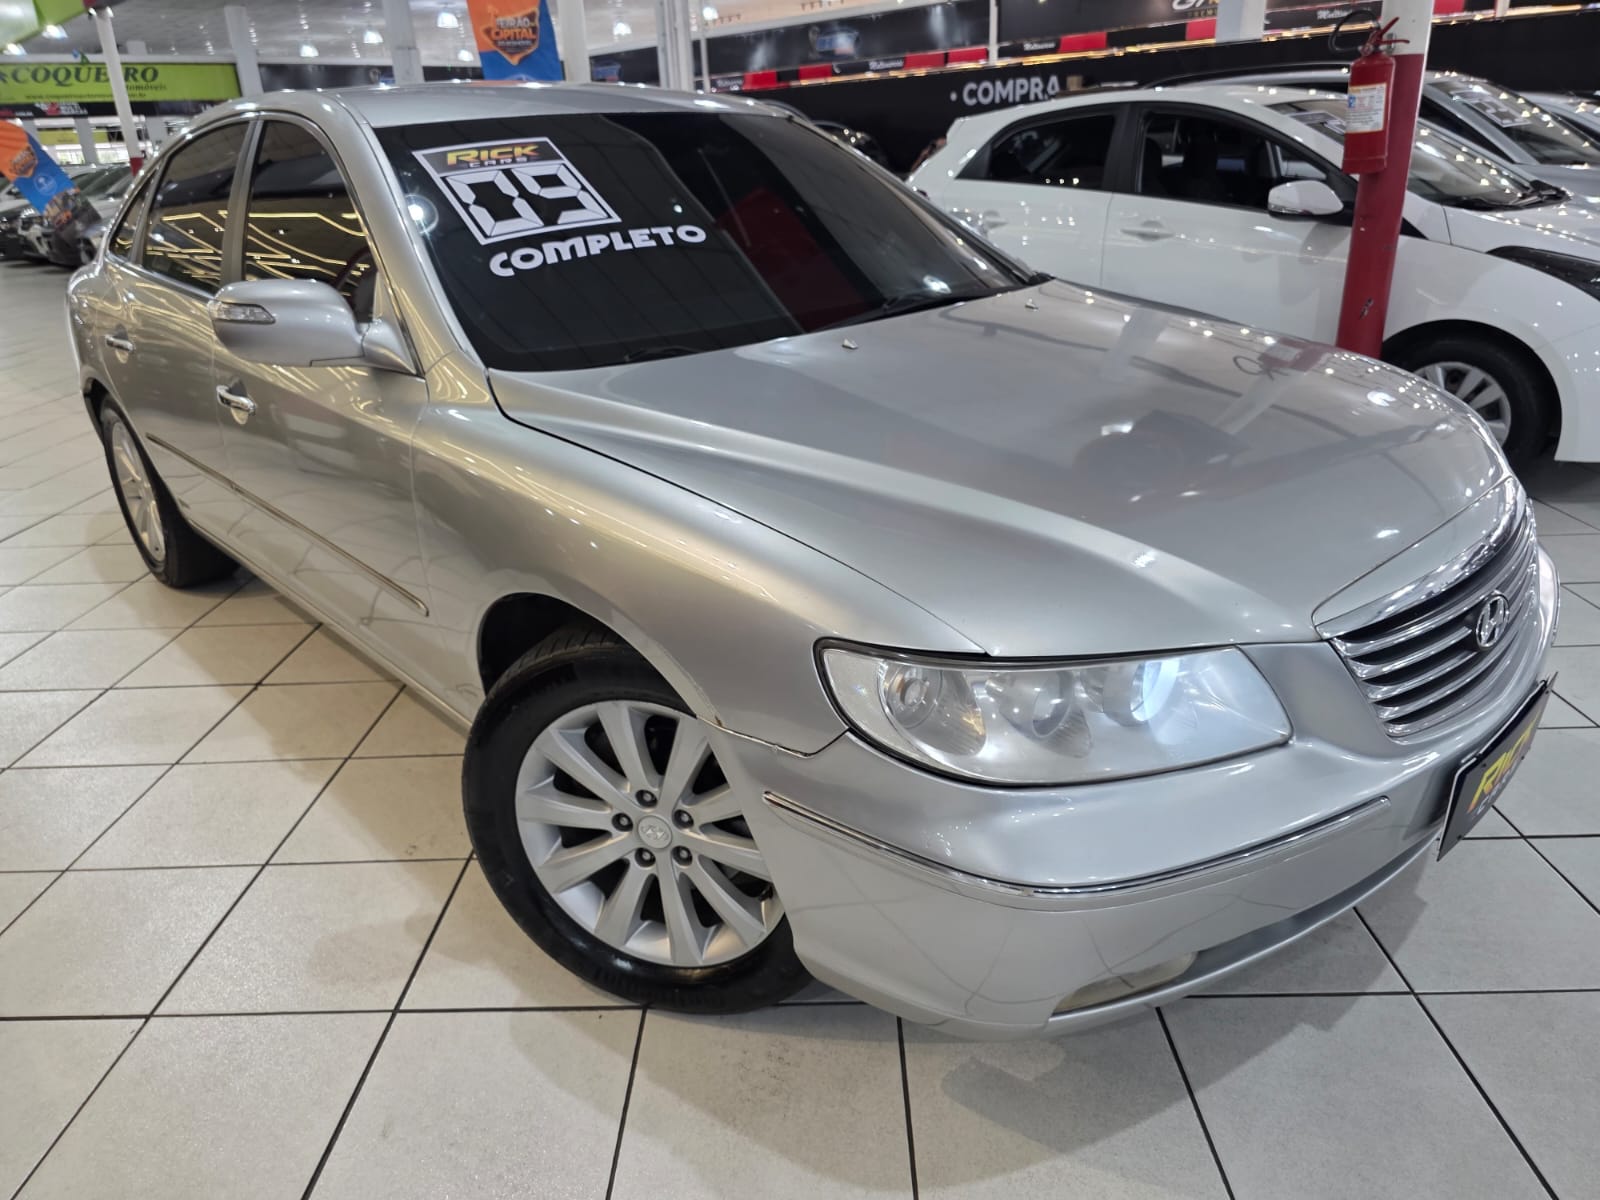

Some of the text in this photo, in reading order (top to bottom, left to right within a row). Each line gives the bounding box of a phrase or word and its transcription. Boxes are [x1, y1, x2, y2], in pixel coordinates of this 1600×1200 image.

[11, 65, 159, 87] COQUERO
[962, 75, 1062, 106] COMPRA
[446, 144, 540, 166] RICK
[467, 157, 529, 168] CARS
[444, 163, 610, 237] 09
[488, 225, 707, 277] COMPLETO
